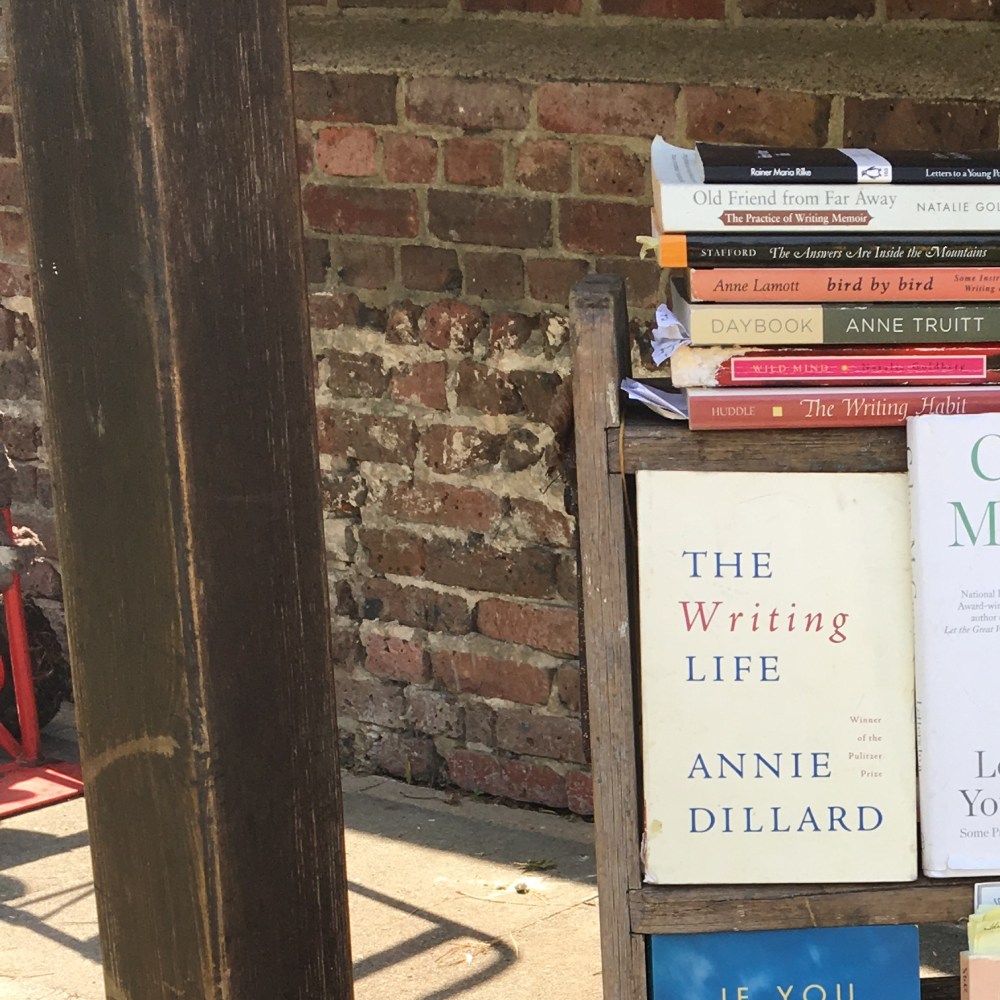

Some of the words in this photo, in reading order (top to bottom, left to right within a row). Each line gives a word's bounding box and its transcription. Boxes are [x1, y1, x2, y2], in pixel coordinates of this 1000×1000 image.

[750, 168, 772, 177] Rainer
[772, 168, 795, 177] Maria
[796, 168, 812, 177] Rilke
[926, 169, 953, 178] Letters
[954, 170, 961, 178] to
[967, 169, 991, 180] Young
[693, 190, 722, 206] Old
[728, 190, 777, 206] Friend
[783, 190, 819, 206] from
[825, 190, 850, 205] Far
[855, 191, 897, 209] Away
[916, 202, 969, 212] NATALIE
[725, 212, 742, 223] The
[746, 212, 779, 223] Practice
[783, 212, 793, 223] of
[794, 212, 829, 225] Writing
[832, 212, 868, 223] Memoir
[701, 248, 757, 257] STAFFORD
[770, 247, 790, 259] The
[793, 246, 842, 259] Answers
[846, 246, 871, 259] Are
[874, 246, 906, 259] Inside
[907, 246, 922, 258] the
[925, 246, 988, 258] Mountains
[954, 274, 976, 282] Some
[712, 278, 749, 292] Anne
[753, 278, 800, 292] Lamott
[827, 276, 863, 292] bird
[870, 276, 890, 294] by
[898, 276, 934, 292] bird
[965, 284, 995, 293] Writing
[712, 318, 813, 334] DAYBOOK
[846, 318, 904, 333] ANNE
[913, 317, 985, 332] TRUITT
[753, 364, 787, 373] WILD
[793, 364, 829, 373] MIND
[711, 406, 755, 416] HUDDLE
[800, 399, 835, 418] The
[842, 398, 909, 422] Writing
[915, 396, 967, 414] Habit
[682, 550, 773, 579] THE
[960, 590, 995, 599] National
[678, 601, 849, 644] Writing
[970, 613, 997, 622] author
[944, 626, 957, 634] Let
[959, 626, 970, 634] the
[972, 625, 994, 634] Great
[686, 656, 780, 682] LIFE
[850, 716, 882, 724] Winner
[857, 734, 867, 742] of
[868, 734, 883, 742] the
[848, 752, 883, 760] Pulitzer
[688, 752, 832, 779] ANNIE
[860, 770, 883, 778] Prize
[688, 806, 884, 834] DILLARD
[959, 828, 990, 839] Some
